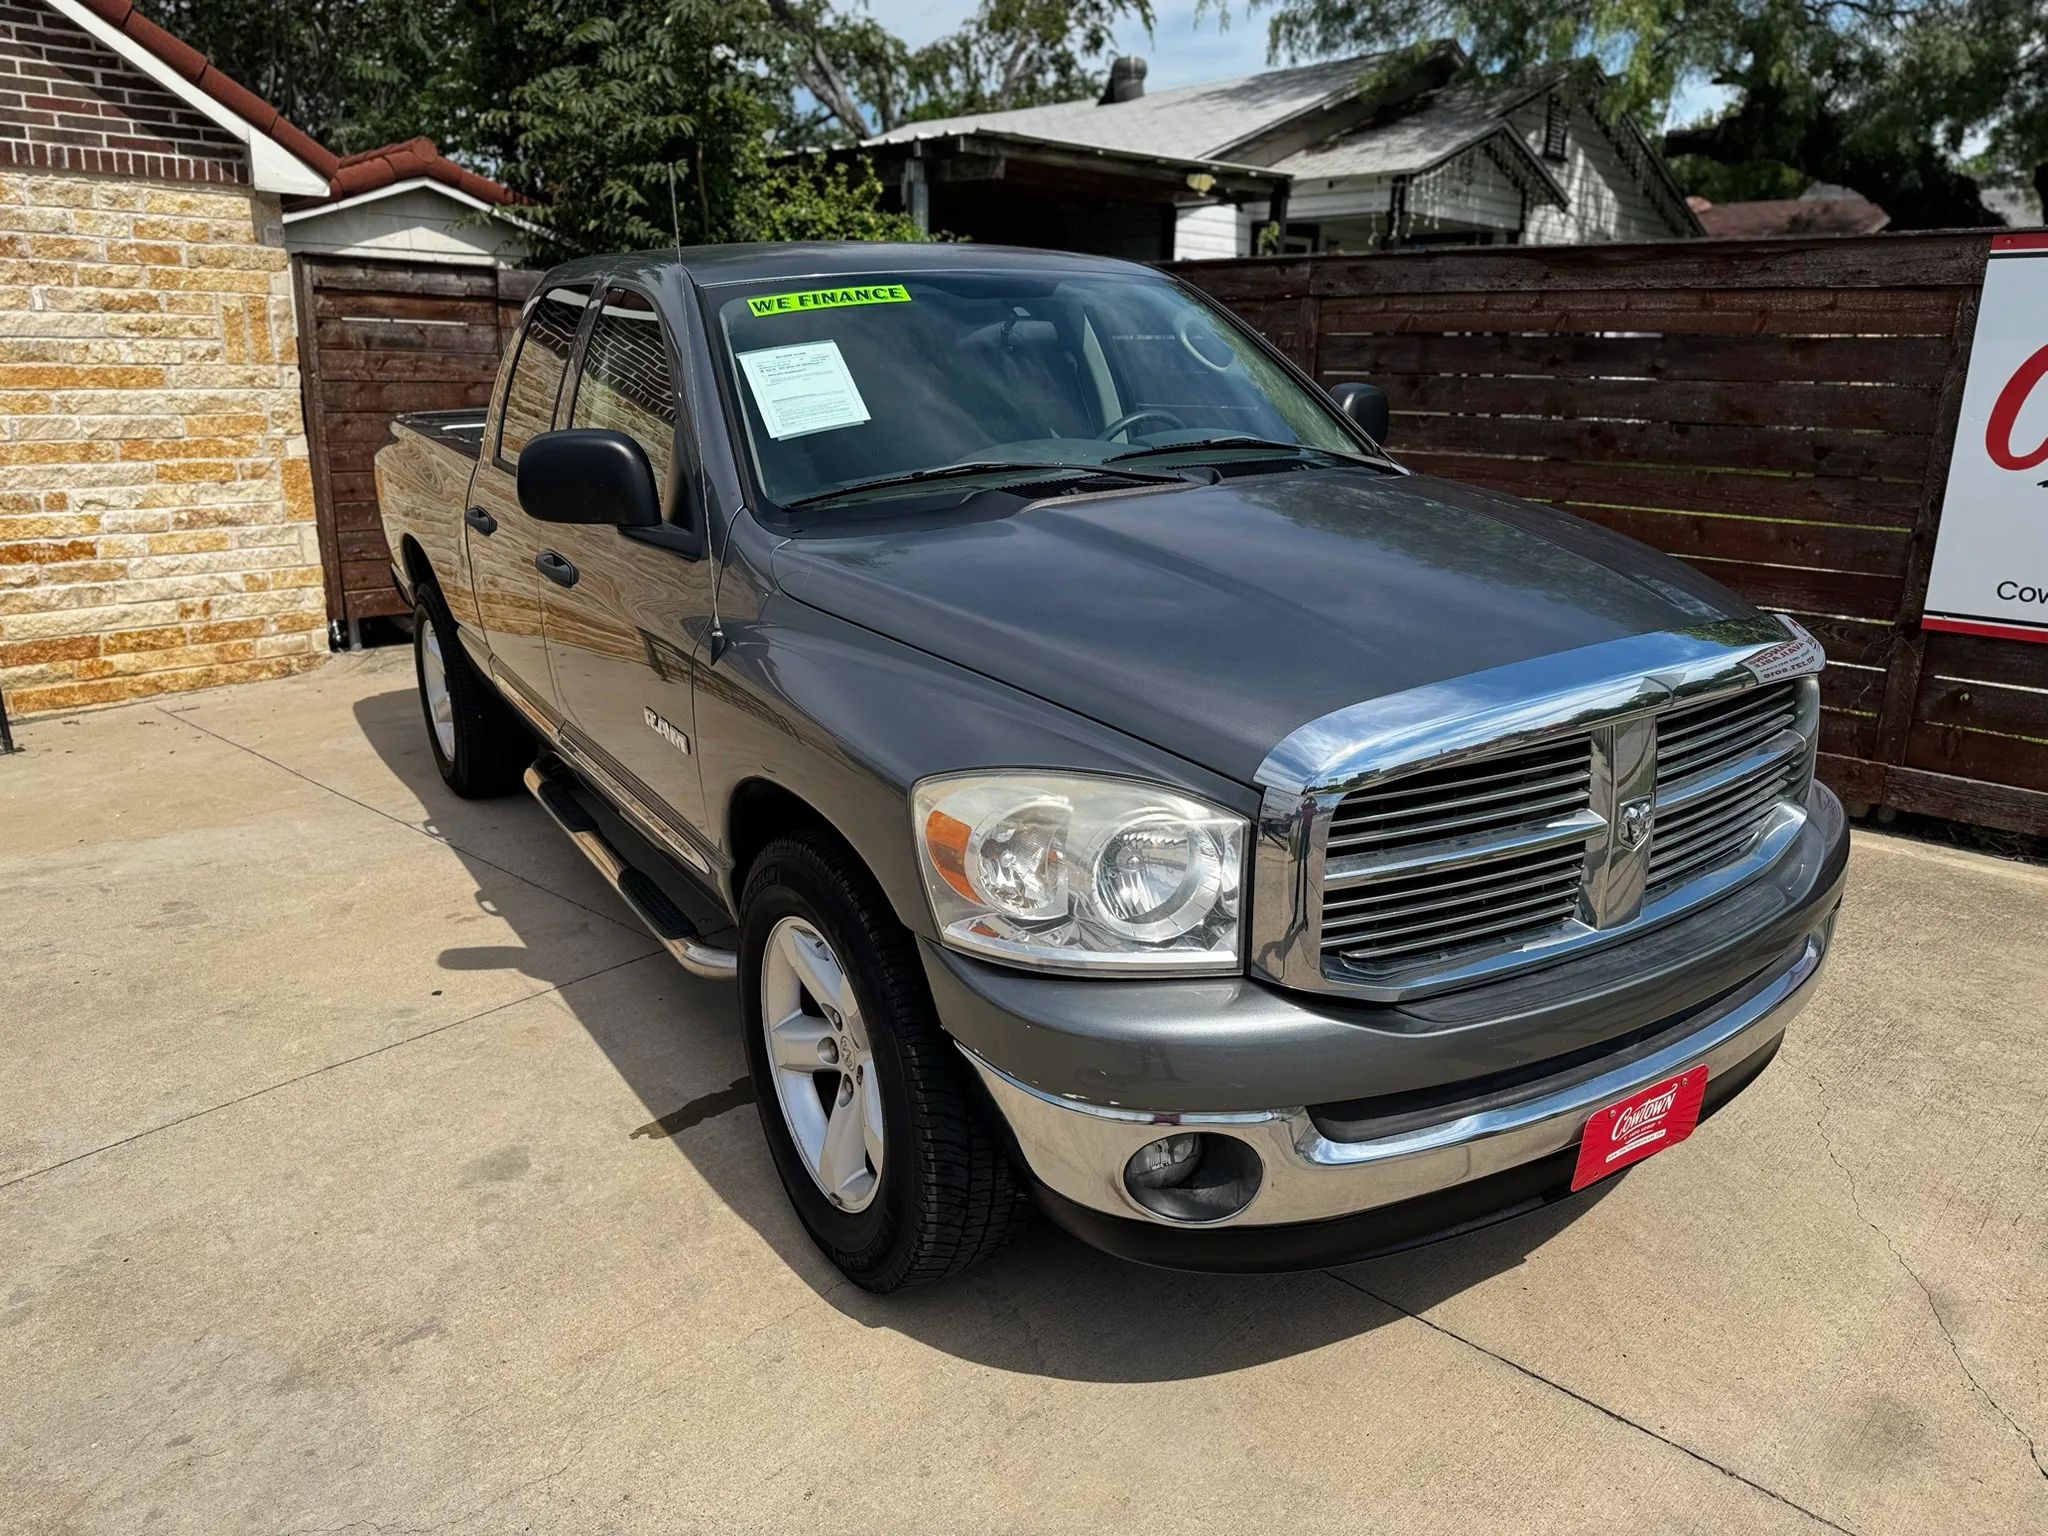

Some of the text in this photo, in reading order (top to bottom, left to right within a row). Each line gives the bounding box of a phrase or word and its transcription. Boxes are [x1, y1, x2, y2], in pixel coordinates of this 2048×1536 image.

[752, 287, 902, 313] WE FINANCE
[643, 706, 691, 755] RAM
